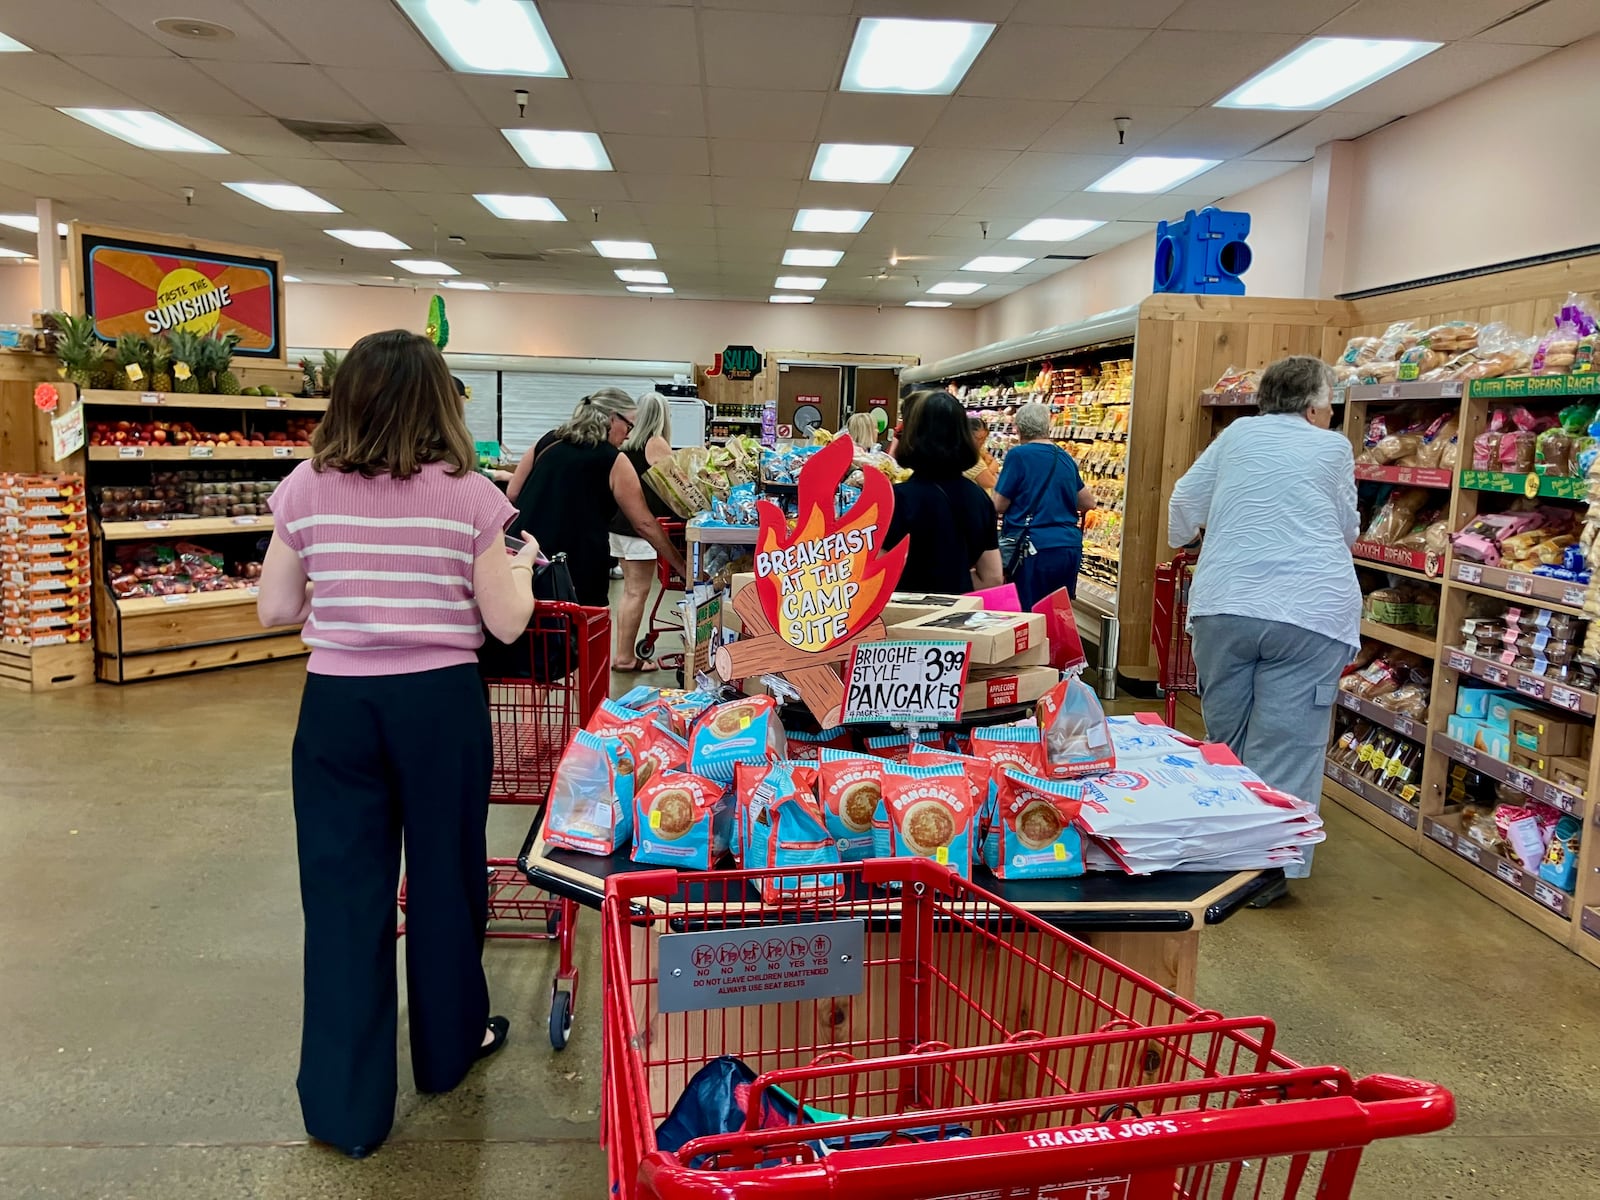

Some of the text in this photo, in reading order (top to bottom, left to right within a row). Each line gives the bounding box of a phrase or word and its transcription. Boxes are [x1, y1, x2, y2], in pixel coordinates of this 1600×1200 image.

[158, 278, 208, 304] TASTE THE
[144, 284, 232, 334] SUNSHINE
[724, 350, 758, 370] SALAD
[756, 525, 878, 577] BREAKFAST
[781, 558, 852, 596] AT THE
[781, 582, 859, 620] CAMP
[788, 612, 848, 645] SITE
[856, 647, 917, 665] BRIOCHE
[924, 648, 966, 682] 3.99
[853, 664, 901, 682] STYLE
[847, 683, 962, 710] PANCAKES
[989, 682, 1015, 693] APPLE CIDER
[994, 696, 1011, 704] DONUTS
[829, 770, 881, 795] PANCAK
[834, 764, 864, 778] BRIOCHE
[893, 787, 964, 812] PANCAKES
[898, 781, 932, 793] BRIOCHE
[934, 782, 956, 793] STYLE
[694, 967, 829, 987] DO NOT LEAVE CHILDREN UNATTENDED
[697, 957, 828, 977] NO NO NO NO YES YES
[718, 979, 805, 994] ALWAYS USE SEAT BELTS
[1023, 1119, 1178, 1148] TRADER JOE'S
